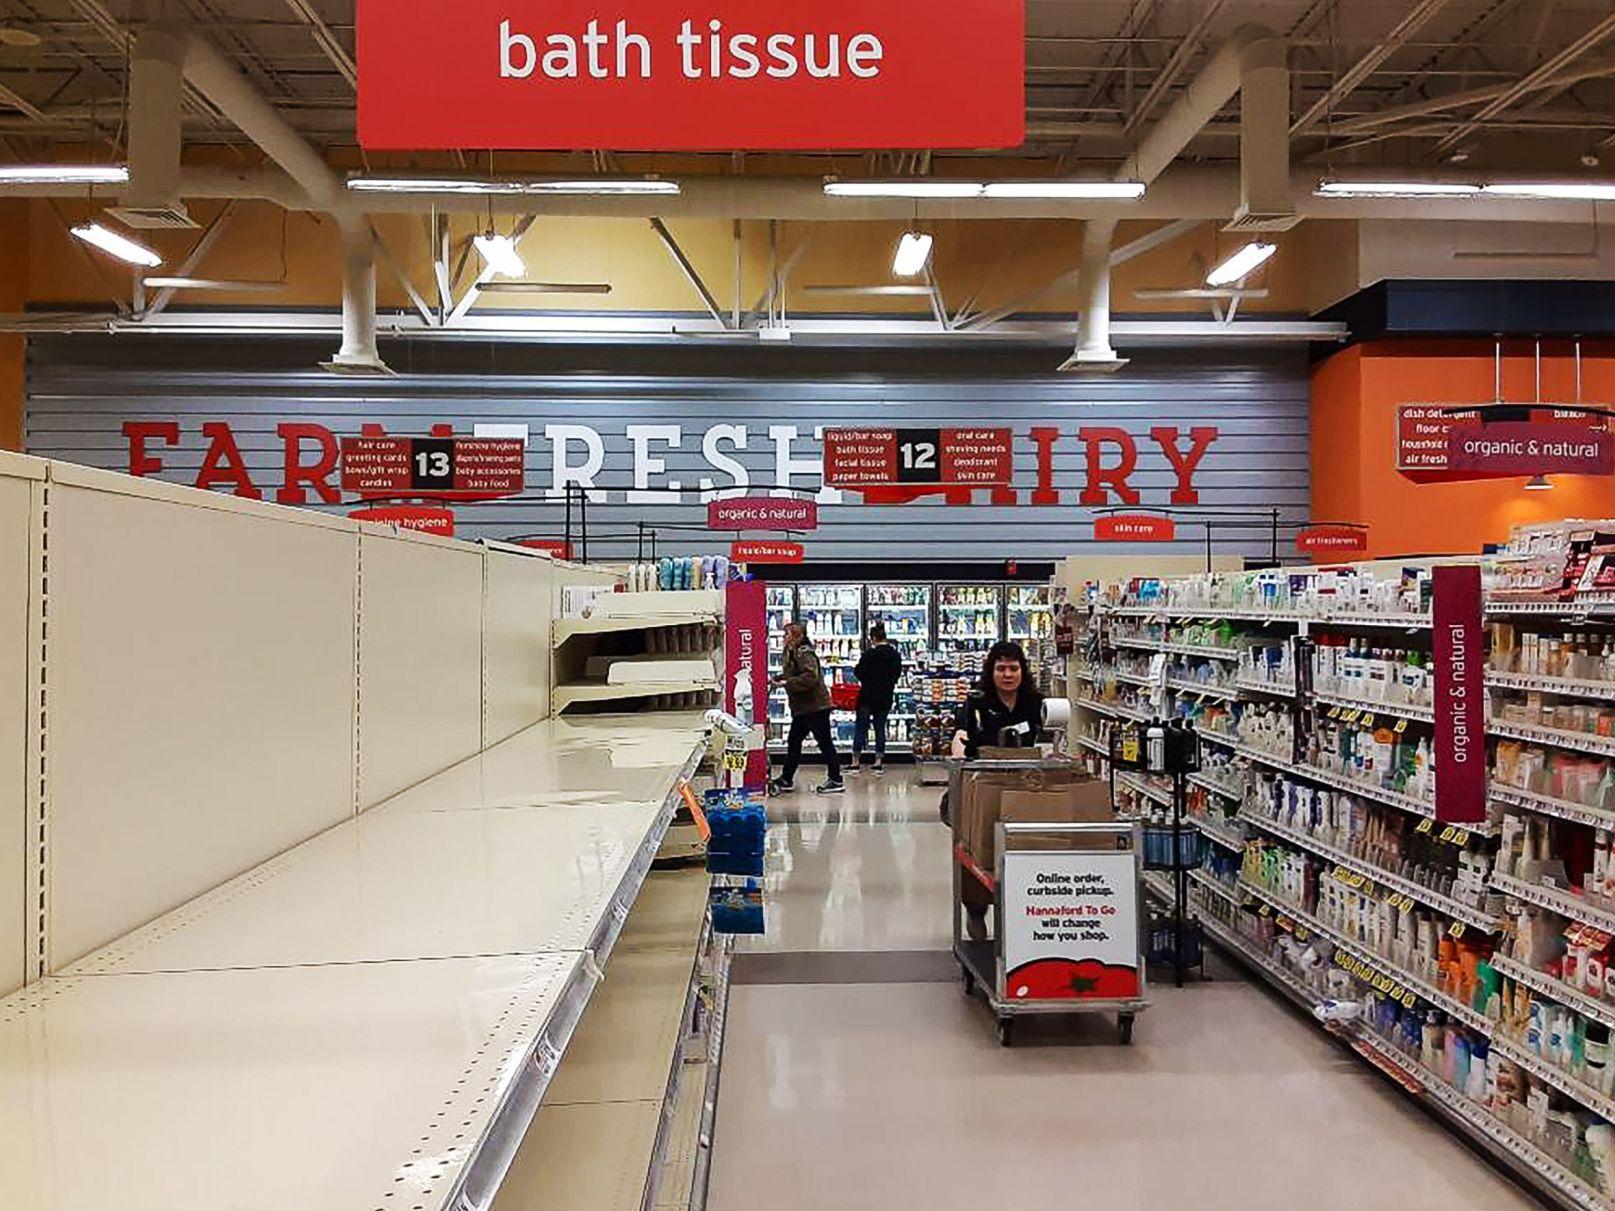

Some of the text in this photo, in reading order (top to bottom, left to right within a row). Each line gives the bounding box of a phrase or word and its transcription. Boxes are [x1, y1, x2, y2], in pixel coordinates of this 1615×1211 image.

[499, 18, 884, 79] bath tissue
[1416, 423, 1439, 433] floor
[1464, 438, 1523, 458] organic
[1527, 439, 1541, 456] &
[1543, 441, 1598, 457] natural
[900, 442, 936, 469] 12
[1421, 454, 1448, 463] fresh
[121, 421, 455, 505] FAR
[415, 452, 450, 477] 13
[718, 507, 807, 520] organic & natural
[403, 517, 448, 528] hygiene
[738, 629, 753, 672] atural
[1448, 623, 1470, 763] organic & natural
[1036, 873, 1105, 885] Online order,
[1027, 885, 1073, 896] curbside
[1026, 905, 1116, 916] Hannaford To Go
[1041, 918, 1101, 929] will change
[1033, 930, 1109, 942] how you shop.
